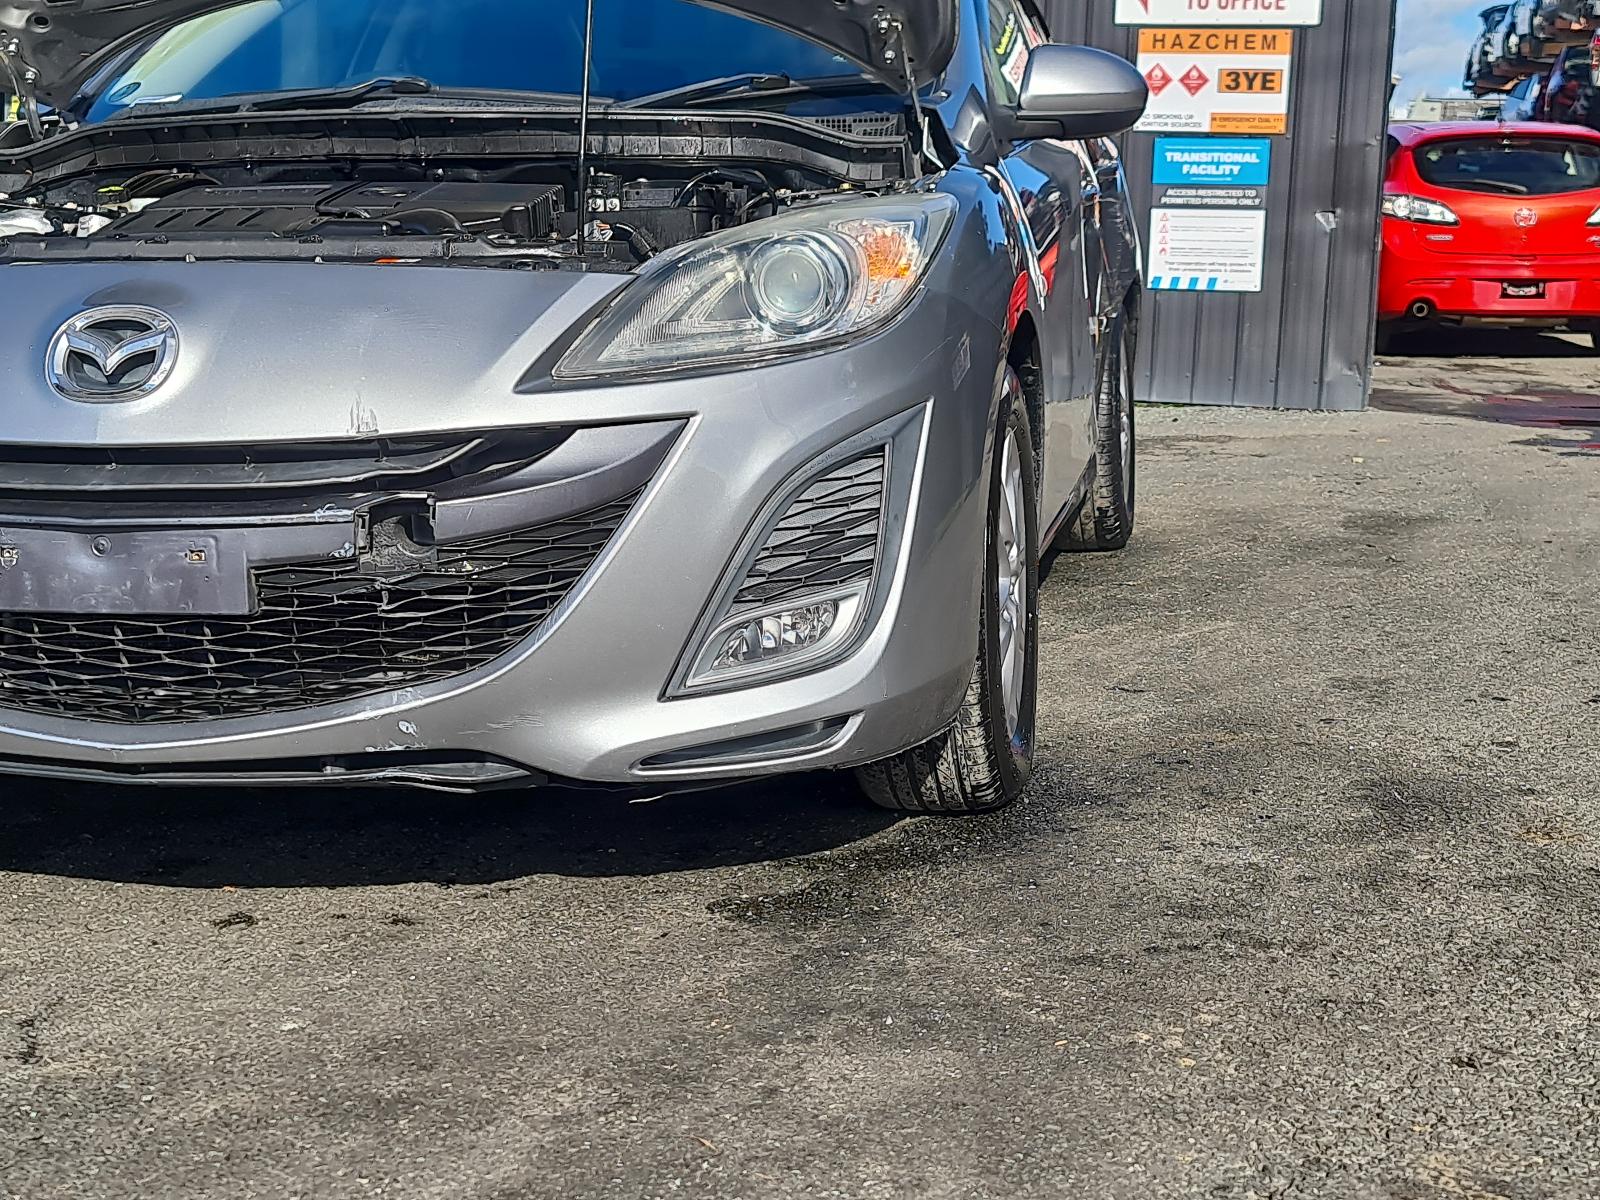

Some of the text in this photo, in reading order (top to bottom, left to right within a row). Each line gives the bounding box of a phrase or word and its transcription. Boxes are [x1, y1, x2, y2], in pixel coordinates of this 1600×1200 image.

[1187, 0, 1286, 11] TO OFFICE
[1152, 33, 1277, 51] HAZCHEM
[1224, 70, 1276, 91] 3YE
[1165, 151, 1260, 163] TRANSITIONAL
[1181, 164, 1241, 175] FACILITY
[1166, 188, 1197, 196] ACCESS
[1244, 189, 1257, 197] TO
